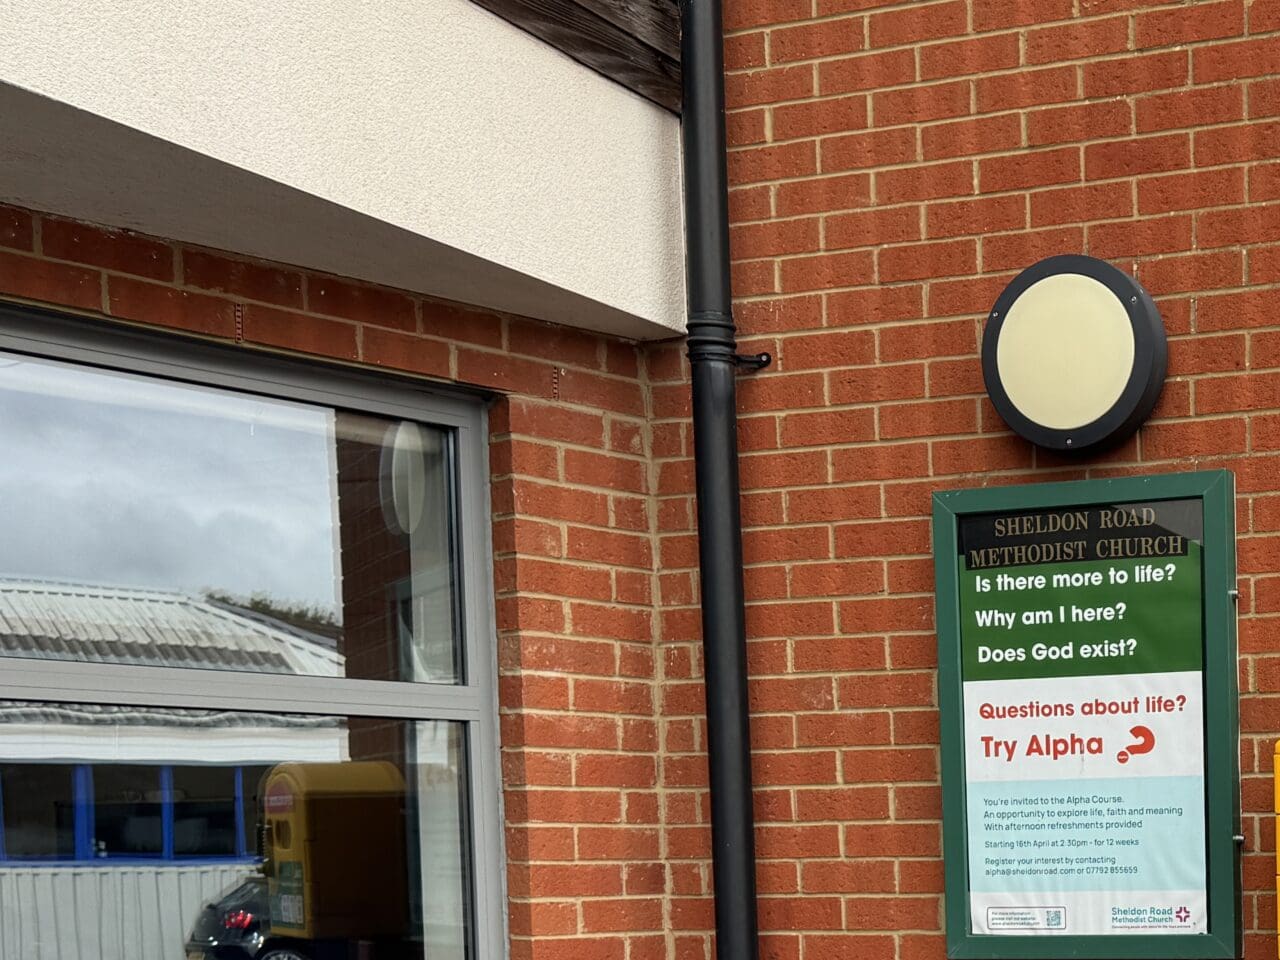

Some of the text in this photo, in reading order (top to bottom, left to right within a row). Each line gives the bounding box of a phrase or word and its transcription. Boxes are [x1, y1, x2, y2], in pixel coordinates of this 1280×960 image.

[994, 507, 1156, 537] SHELDON ROAD
[970, 535, 1183, 568] METHODIST CHURCH
[975, 564, 1177, 592] Is there more to life?
[975, 603, 1127, 629] Why am I here?
[977, 638, 1138, 663] Does God exist?
[979, 694, 1187, 720] Questions about life?
[981, 733, 1104, 760] Try Alpha
[983, 797, 1009, 807] You're
[1010, 796, 1039, 806] invited
[1040, 797, 1049, 805] to
[1050, 796, 1065, 805] the
[1066, 796, 1090, 807] Alpha
[984, 806, 1183, 821] An opportunity to explore life, faith and meaning
[984, 819, 1143, 831] With afternoon refreshments provided
[984, 840, 1015, 850] Starting
[1032, 839, 1050, 849] April
[1094, 838, 1105, 846] for
[1106, 838, 1114, 846] 12
[1115, 838, 1140, 846] weeks
[984, 856, 1116, 867] Register your interest by contacting
[1111, 906, 1173, 916] Sheldon Road
